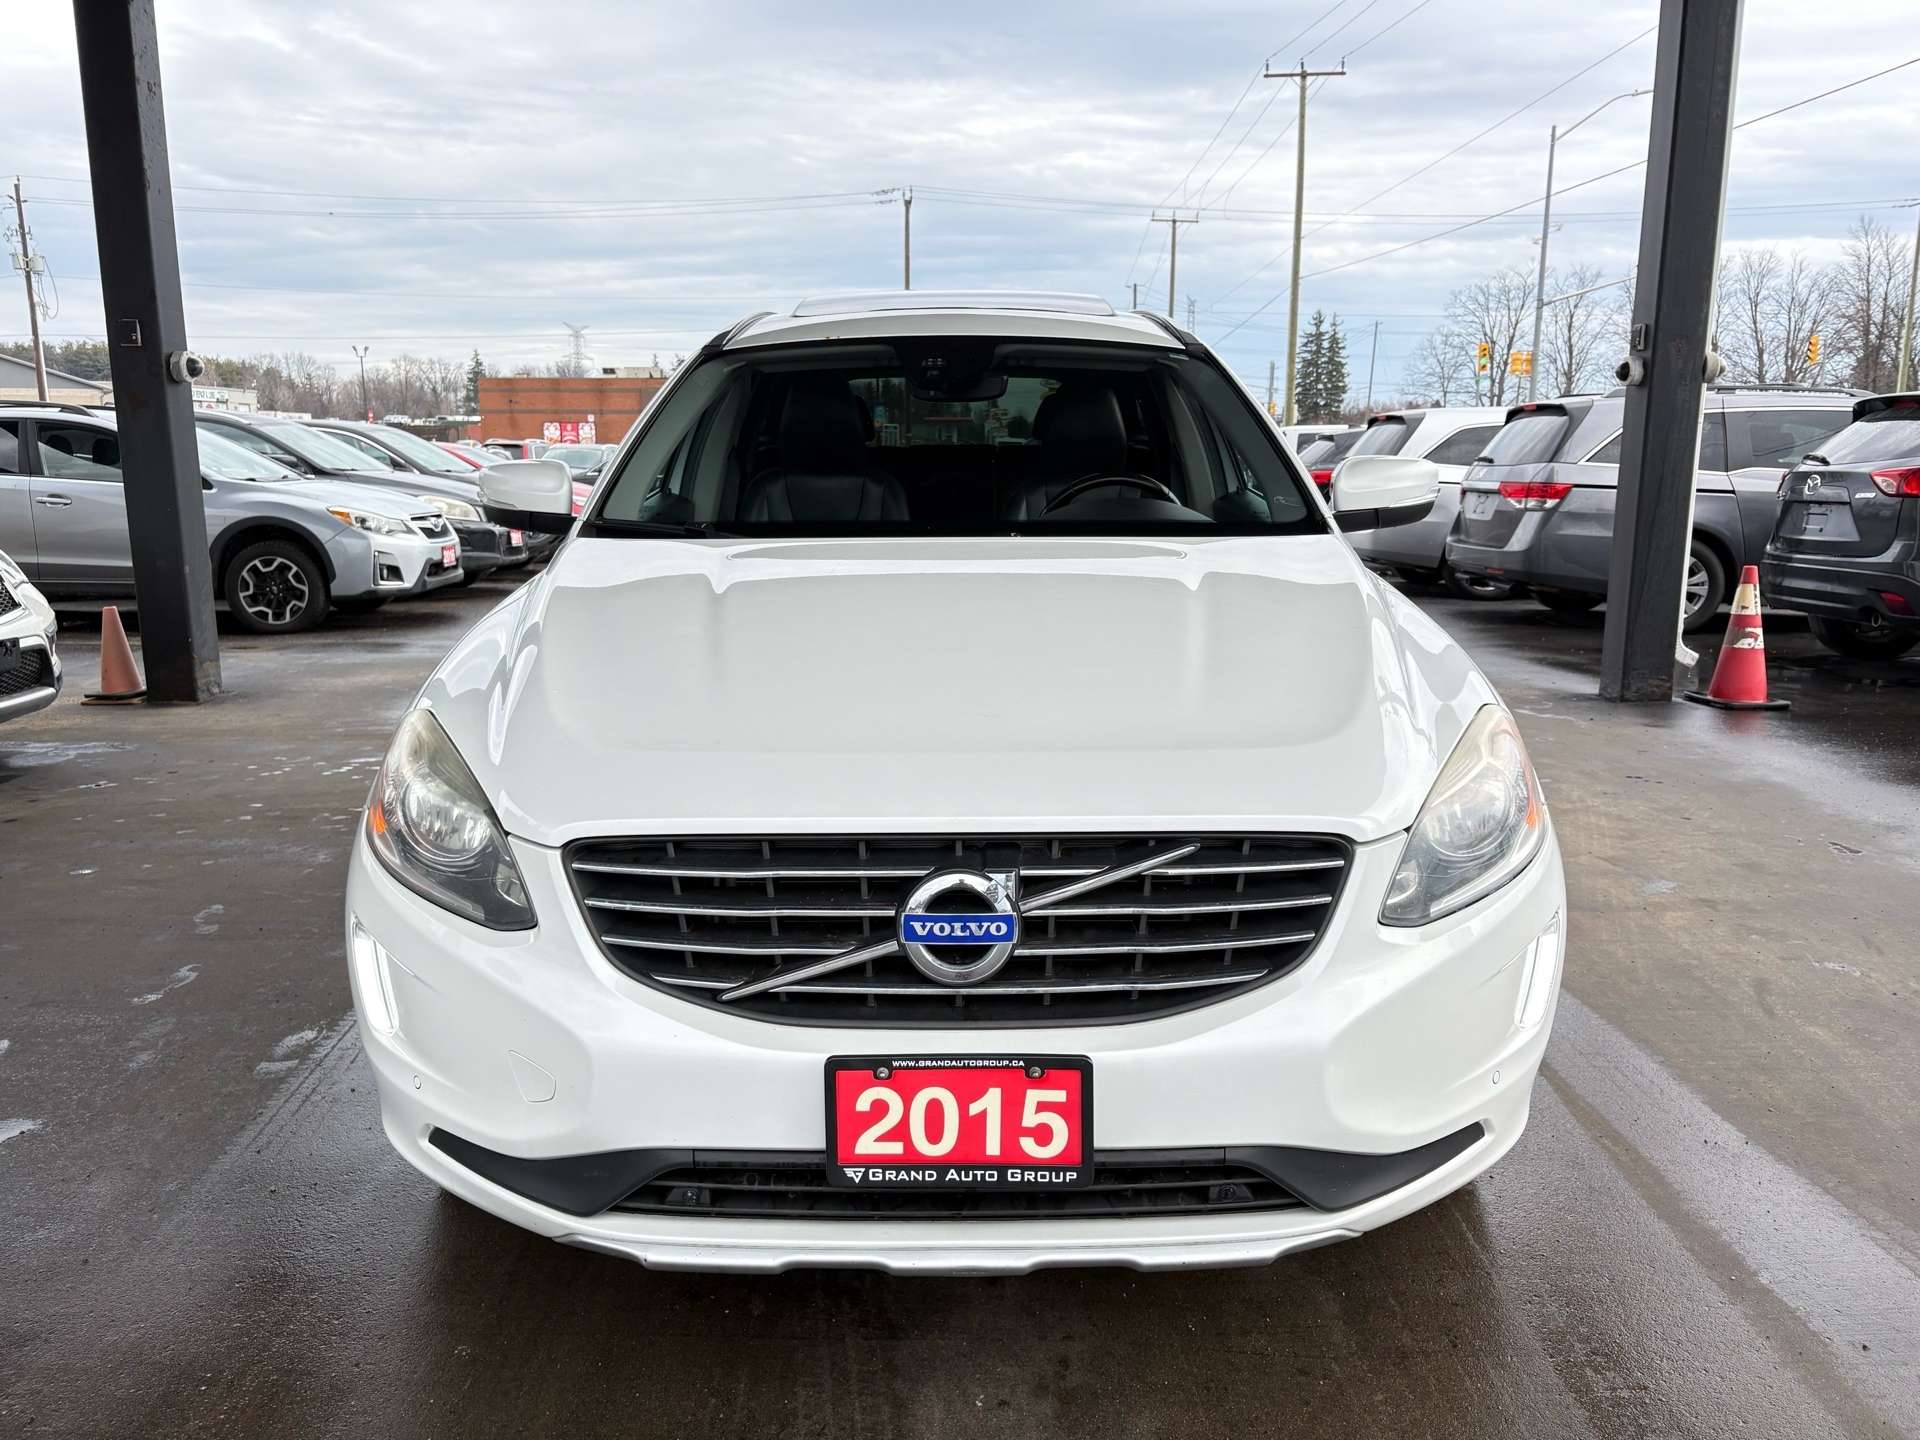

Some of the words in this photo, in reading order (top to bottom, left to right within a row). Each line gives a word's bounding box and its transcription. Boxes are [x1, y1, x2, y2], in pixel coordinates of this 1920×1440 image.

[910, 922, 1008, 936] VOLVO
[854, 1086, 1069, 1159] 2015
[868, 1168, 937, 1181] GRAND
[945, 1169, 998, 1182] AUTO
[1007, 1169, 1078, 1183] GROUP
